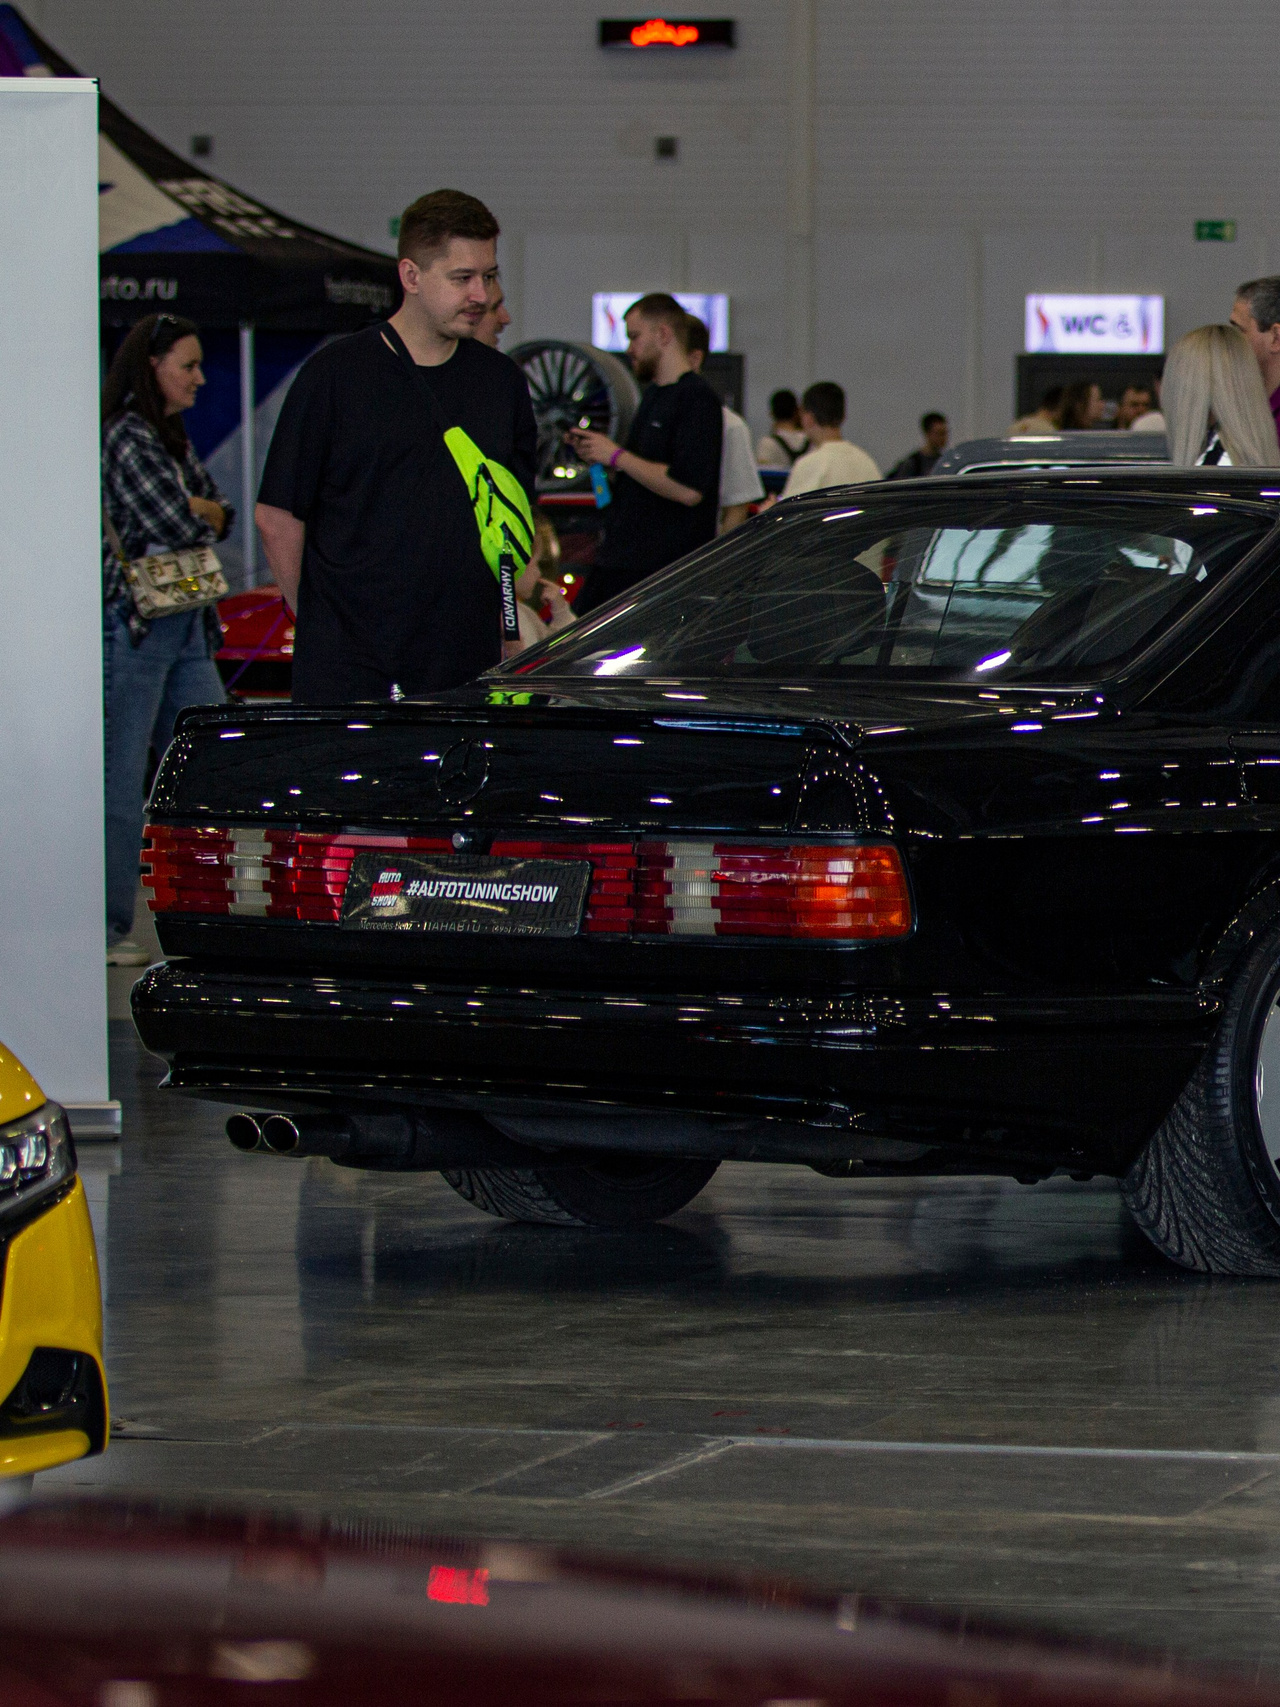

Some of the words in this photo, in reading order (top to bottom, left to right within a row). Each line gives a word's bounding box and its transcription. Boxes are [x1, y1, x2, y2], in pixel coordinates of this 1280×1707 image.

[1062, 313, 1106, 335] WC
[378, 872, 402, 884] AUTO
[406, 880, 559, 902] #AUTOTUNINGSHOW
[371, 895, 398, 907] SHOW
